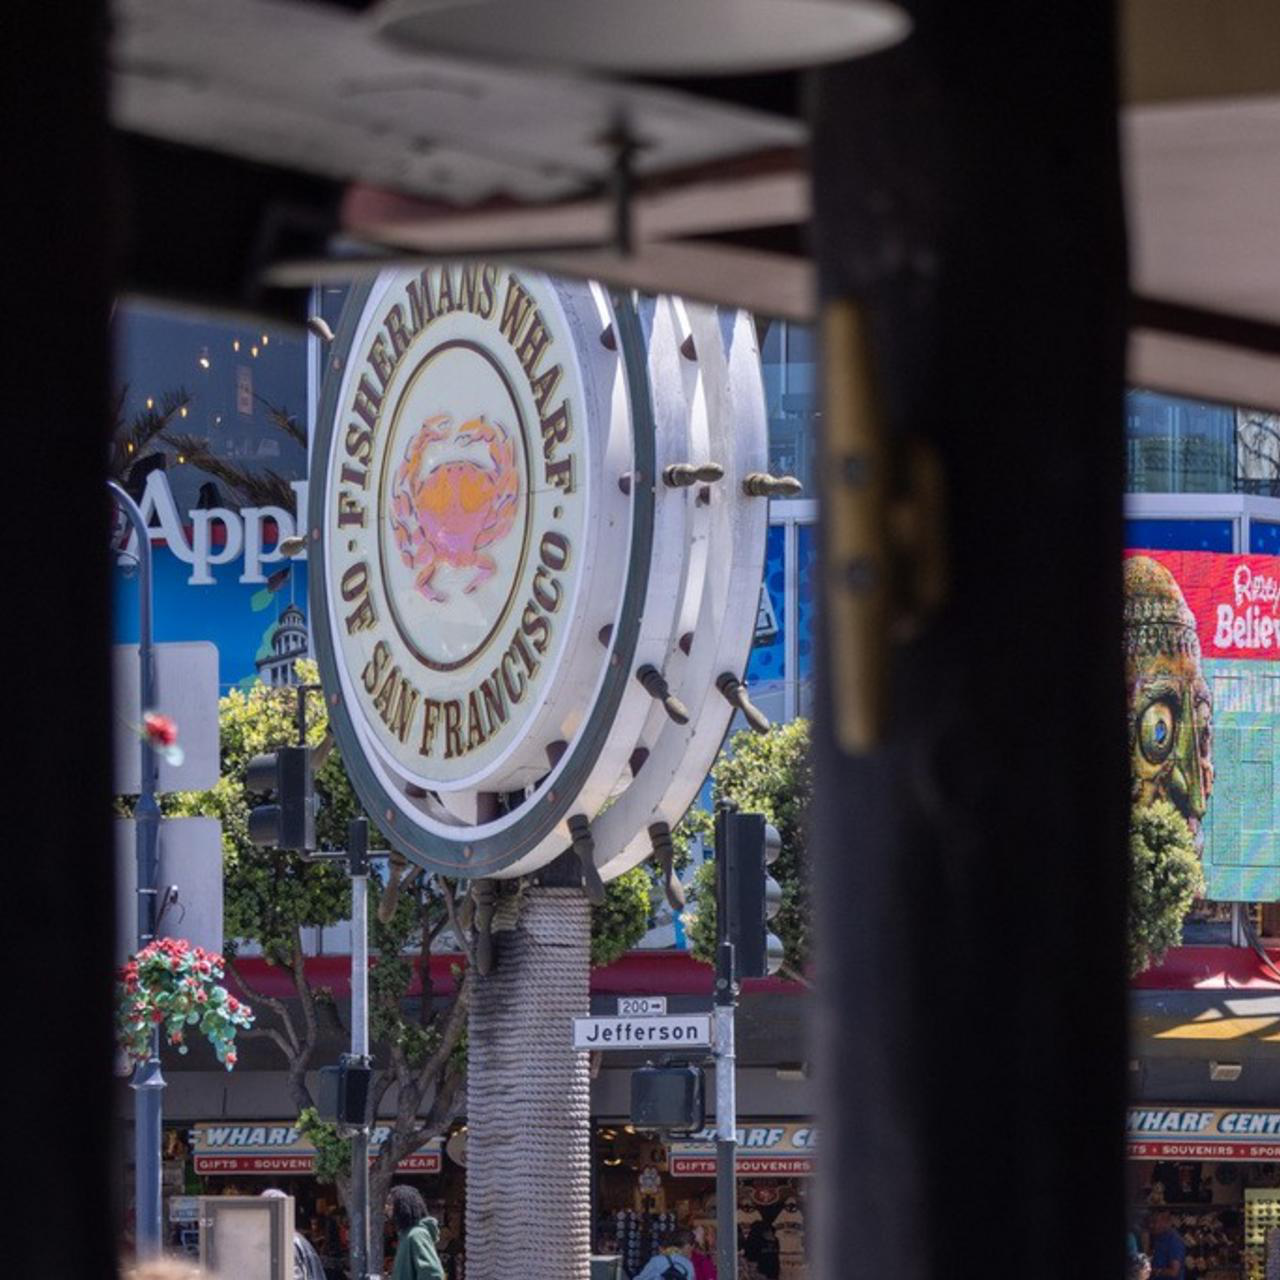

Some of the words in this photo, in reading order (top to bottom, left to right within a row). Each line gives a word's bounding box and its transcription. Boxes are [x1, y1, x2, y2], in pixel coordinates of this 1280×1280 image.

[499, 273, 576, 494] WHARF
[341, 562, 378, 635] OF
[361, 640, 421, 743] SAN
[419, 531, 570, 758] FRANCISCO
[622, 1000, 649, 1013] 200
[586, 1023, 699, 1042] Jefferson
[1127, 1112, 1215, 1131] WHARF
[1162, 1146, 1234, 1156] SOUVENIRS
[199, 1159, 238, 1170] GIFTS
[676, 1161, 716, 1171] GIFTS
